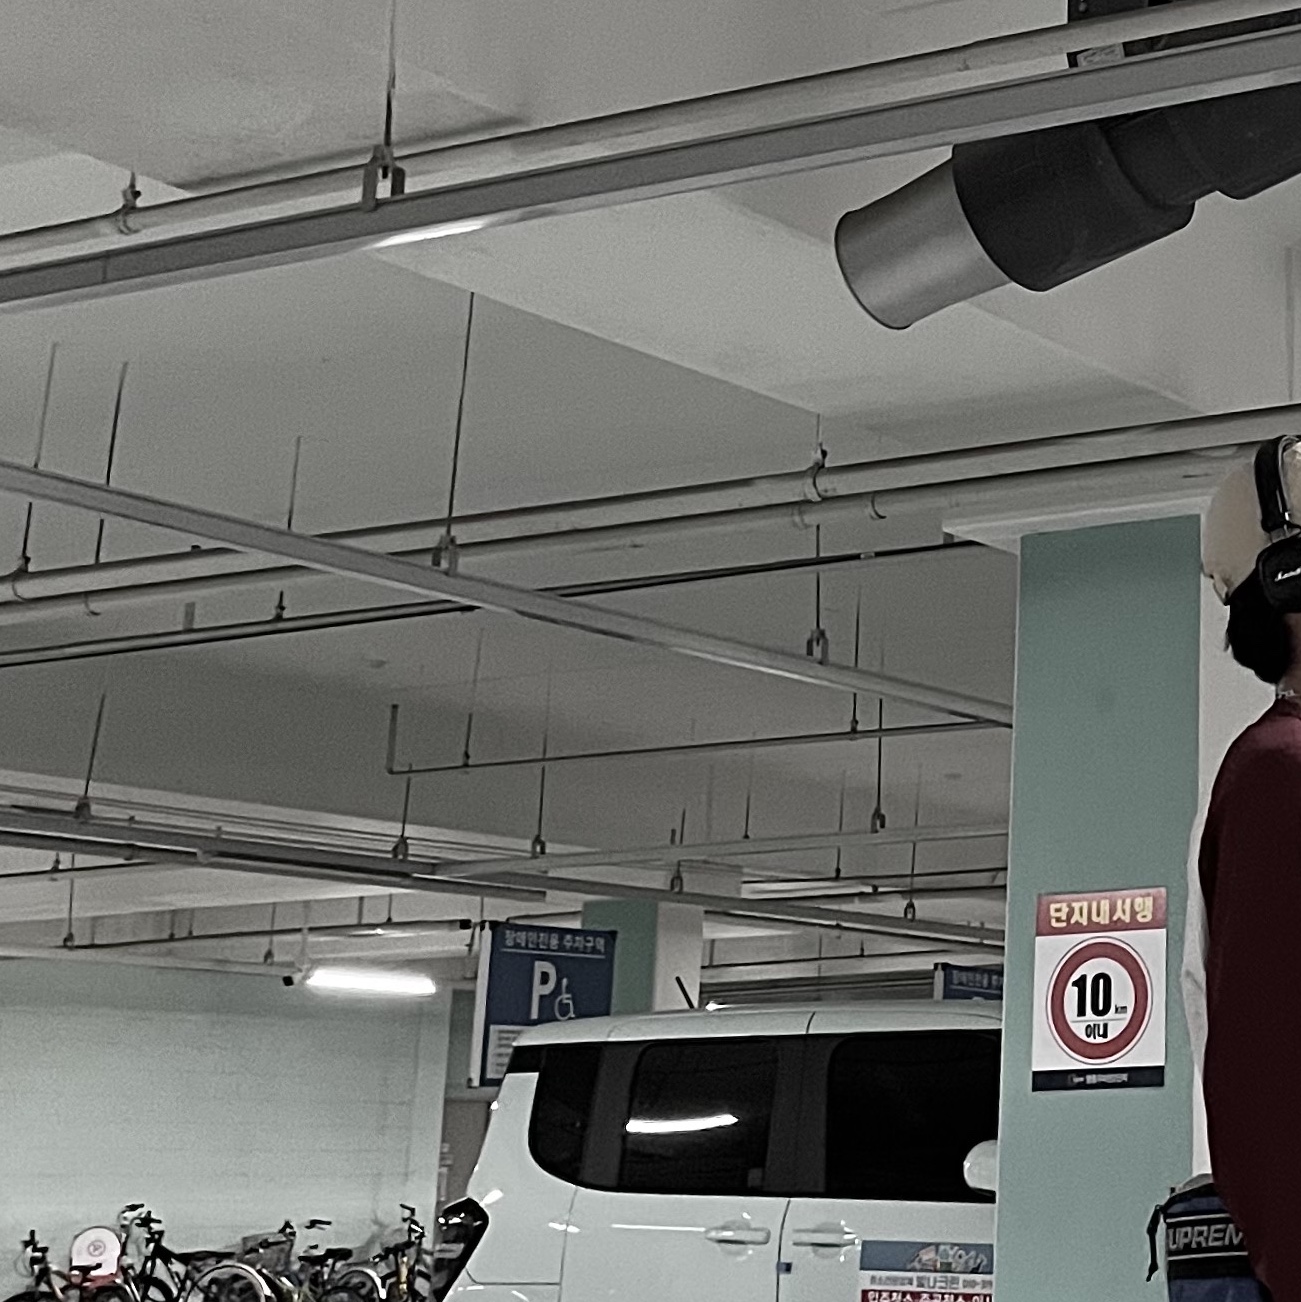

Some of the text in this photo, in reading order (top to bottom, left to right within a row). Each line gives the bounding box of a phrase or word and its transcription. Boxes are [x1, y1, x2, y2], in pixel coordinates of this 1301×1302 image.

[1049, 895, 1154, 928] 단지내서행
[530, 960, 557, 1020] P
[1071, 972, 1112, 1018] 10
[1085, 1022, 1109, 1040] 이내
